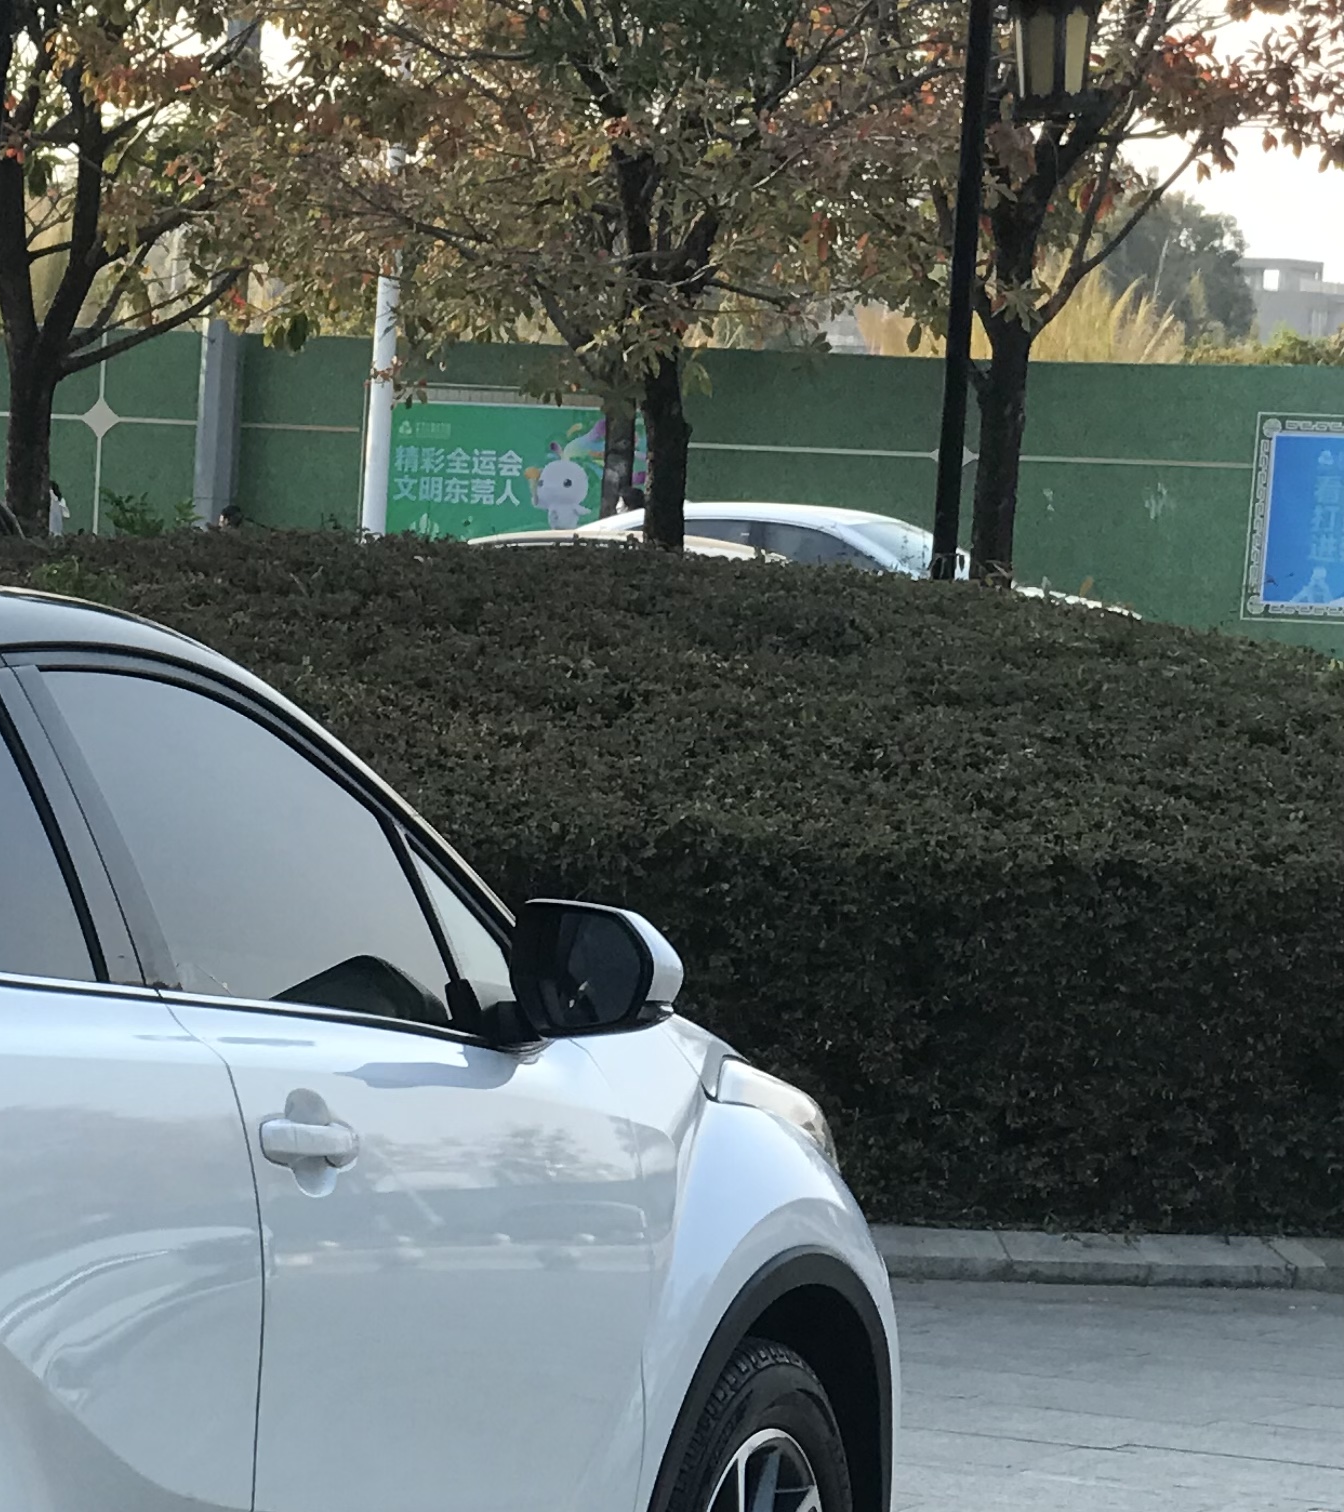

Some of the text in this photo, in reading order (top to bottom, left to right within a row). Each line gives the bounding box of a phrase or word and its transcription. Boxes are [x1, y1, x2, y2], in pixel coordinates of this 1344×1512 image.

[394, 445, 523, 477] 精彩全运会
[392, 475, 521, 507] 文明东莞人
